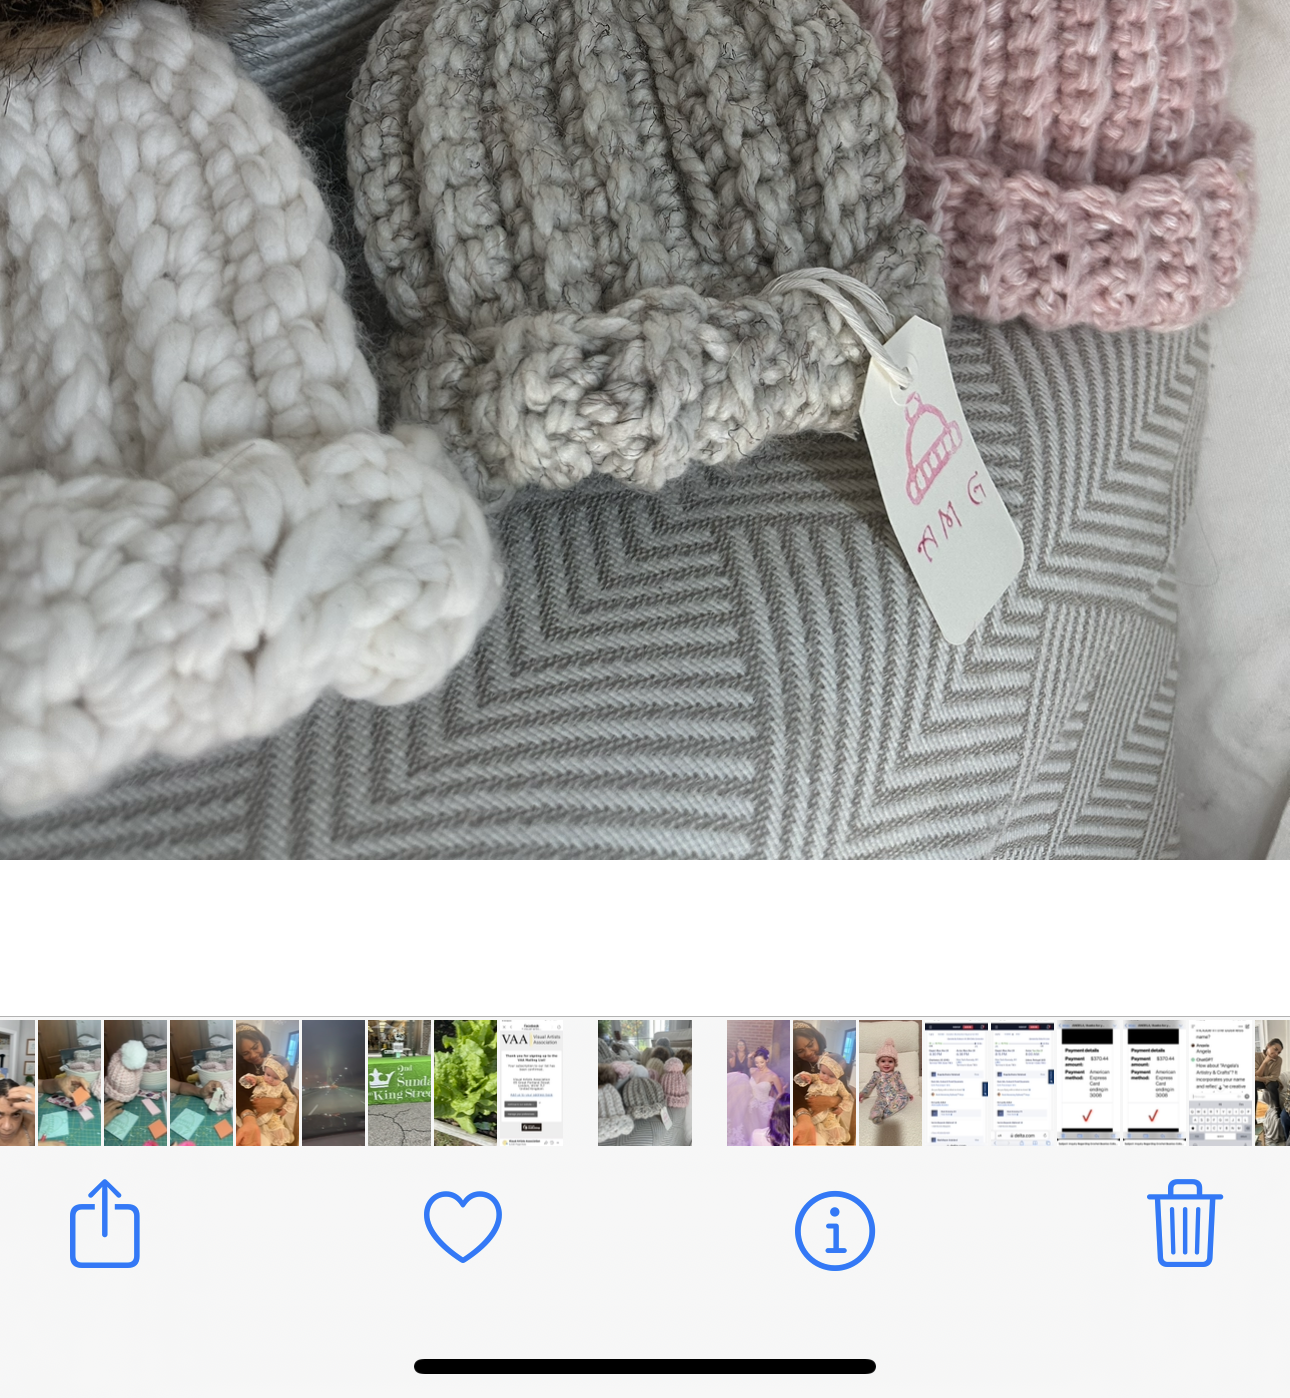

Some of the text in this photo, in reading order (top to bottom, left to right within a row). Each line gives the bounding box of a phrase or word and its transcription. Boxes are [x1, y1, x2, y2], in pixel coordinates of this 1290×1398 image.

[502, 1034, 528, 1044] VAA
[397, 1065, 413, 1073] 2nd
[373, 1090, 403, 1101] King
